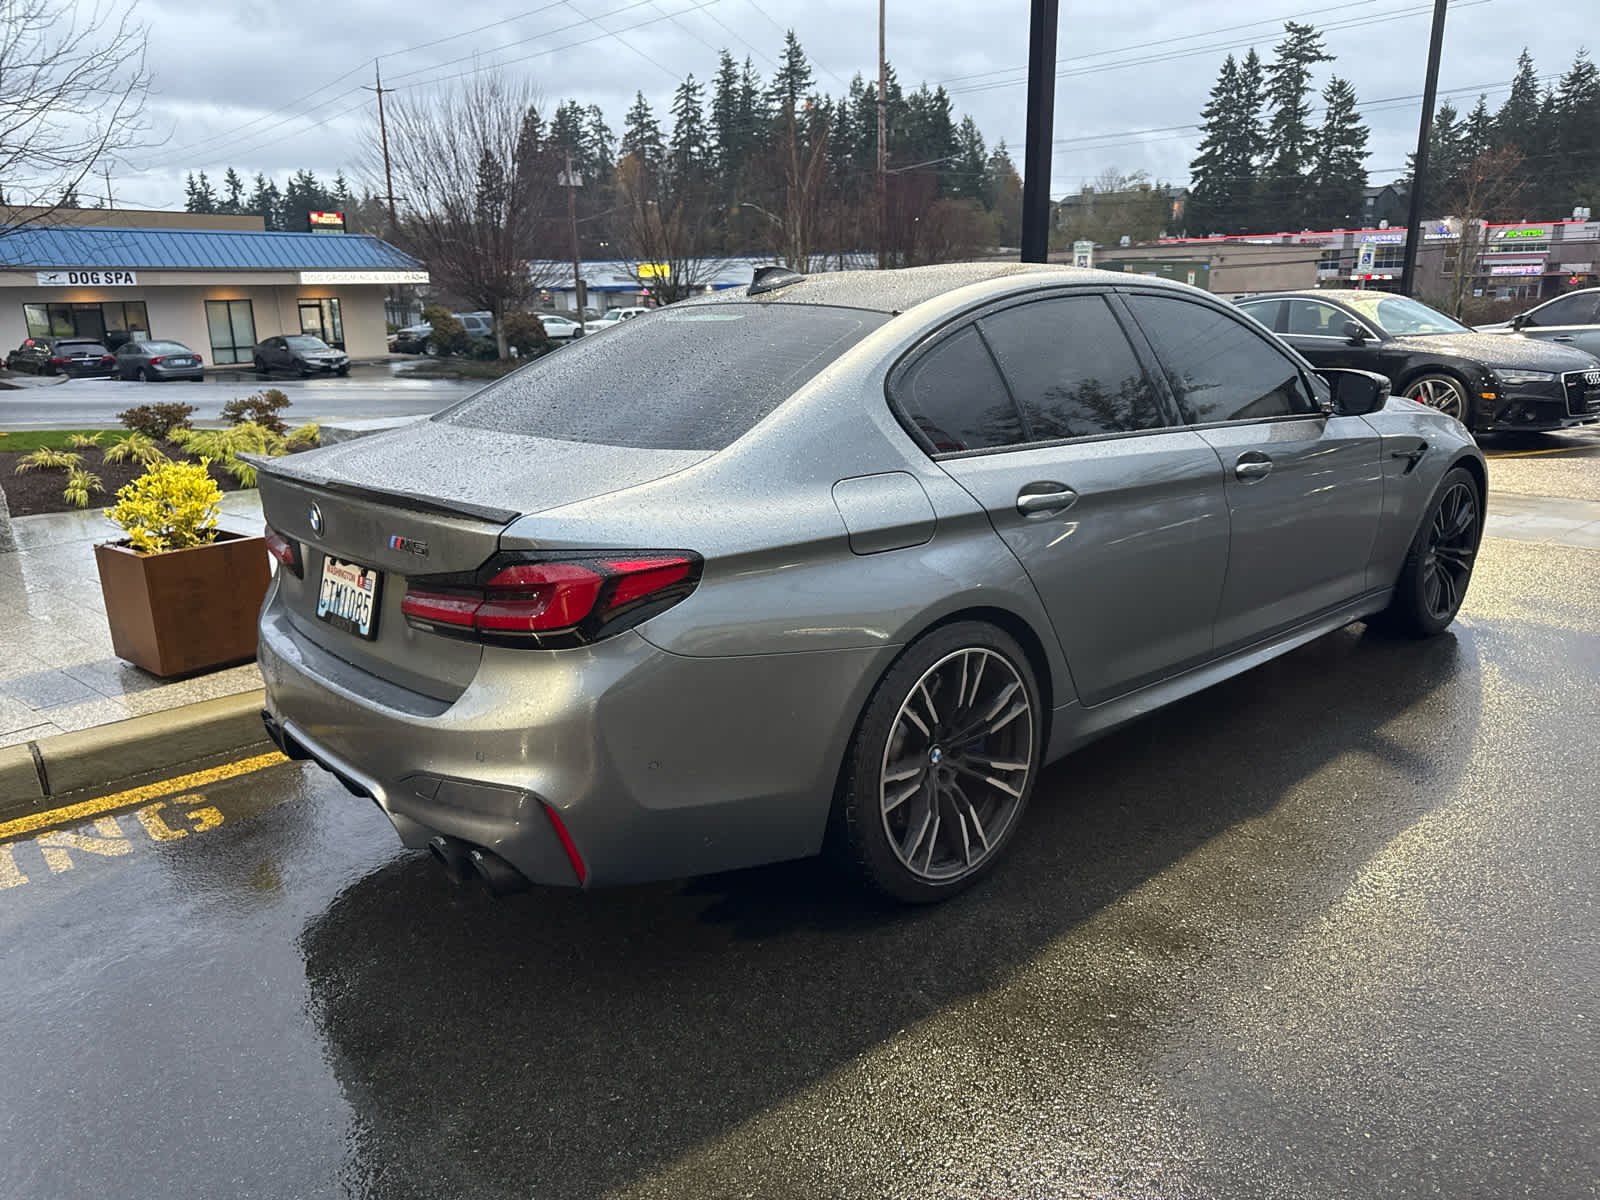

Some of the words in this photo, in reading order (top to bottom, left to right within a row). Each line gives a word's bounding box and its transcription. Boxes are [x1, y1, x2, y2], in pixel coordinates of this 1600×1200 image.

[68, 272, 100, 284] DOG
[104, 272, 133, 284] SPA
[326, 565, 355, 582] WASHINGTON
[320, 578, 371, 626] CTM1085
